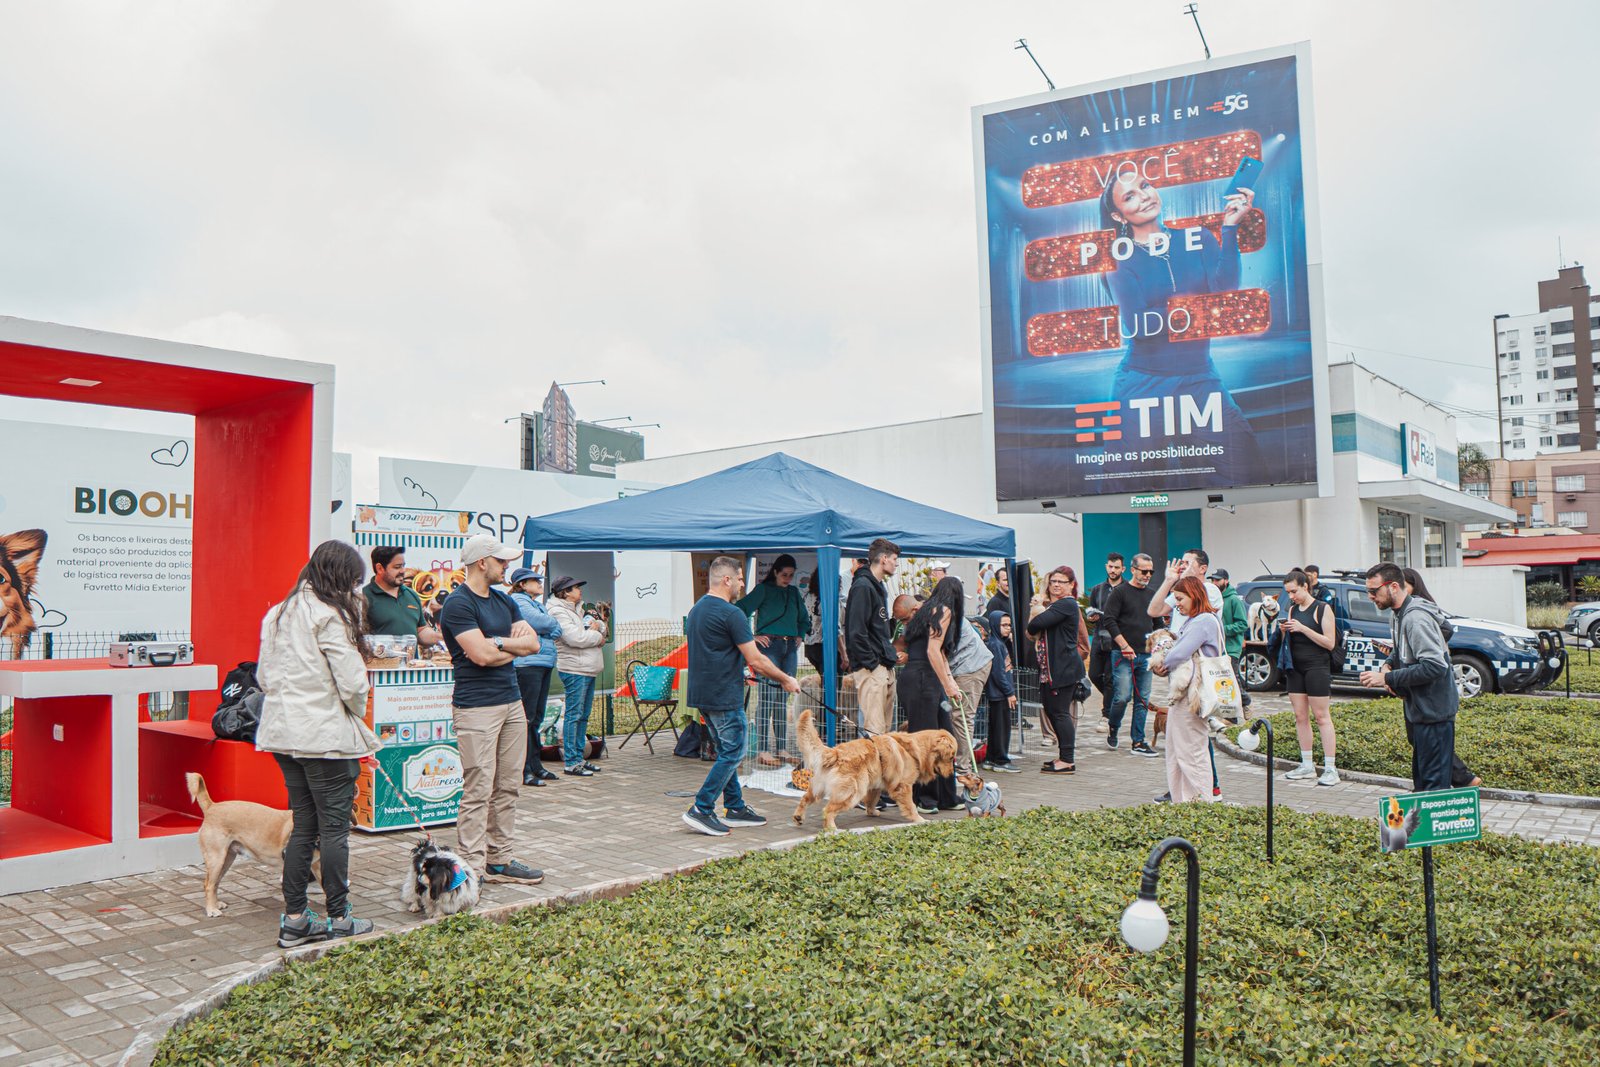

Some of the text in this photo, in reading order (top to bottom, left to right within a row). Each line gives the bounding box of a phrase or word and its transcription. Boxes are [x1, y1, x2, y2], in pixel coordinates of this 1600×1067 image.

[1030, 94, 1249, 146] COM A LÍDER EM 5G
[1093, 147, 1180, 189] VOCÊ
[1080, 226, 1203, 266] PODE
[1096, 307, 1192, 341] TUDO
[1129, 391, 1224, 438] TIM
[1076, 444, 1224, 466] Imagine as possibilidades
[1420, 443, 1434, 467] Raia
[74, 486, 192, 519] BIOOH
[1130, 494, 1168, 504] Favretto
[77, 533, 91, 542] Os
[93, 534, 127, 543] bancos
[136, 535, 168, 545] lixeiras
[72, 547, 107, 556] espaço
[109, 546, 126, 555] são
[128, 548, 177, 557] produzidos
[56, 558, 97, 567] material
[100, 560, 153, 569] proveniente
[155, 560, 167, 568] da
[63, 570, 76, 578] de
[78, 570, 118, 581] logística
[155, 572, 167, 580] de
[168, 572, 191, 580] lonas
[83, 582, 186, 592] Favretto Mídia Exterior
[1422, 801, 1446, 809] Espaço
[1447, 797, 1468, 805] criado
[421, 812, 435, 820] para
[1431, 809, 1459, 818] mantido
[1432, 818, 1475, 832] Favretto
